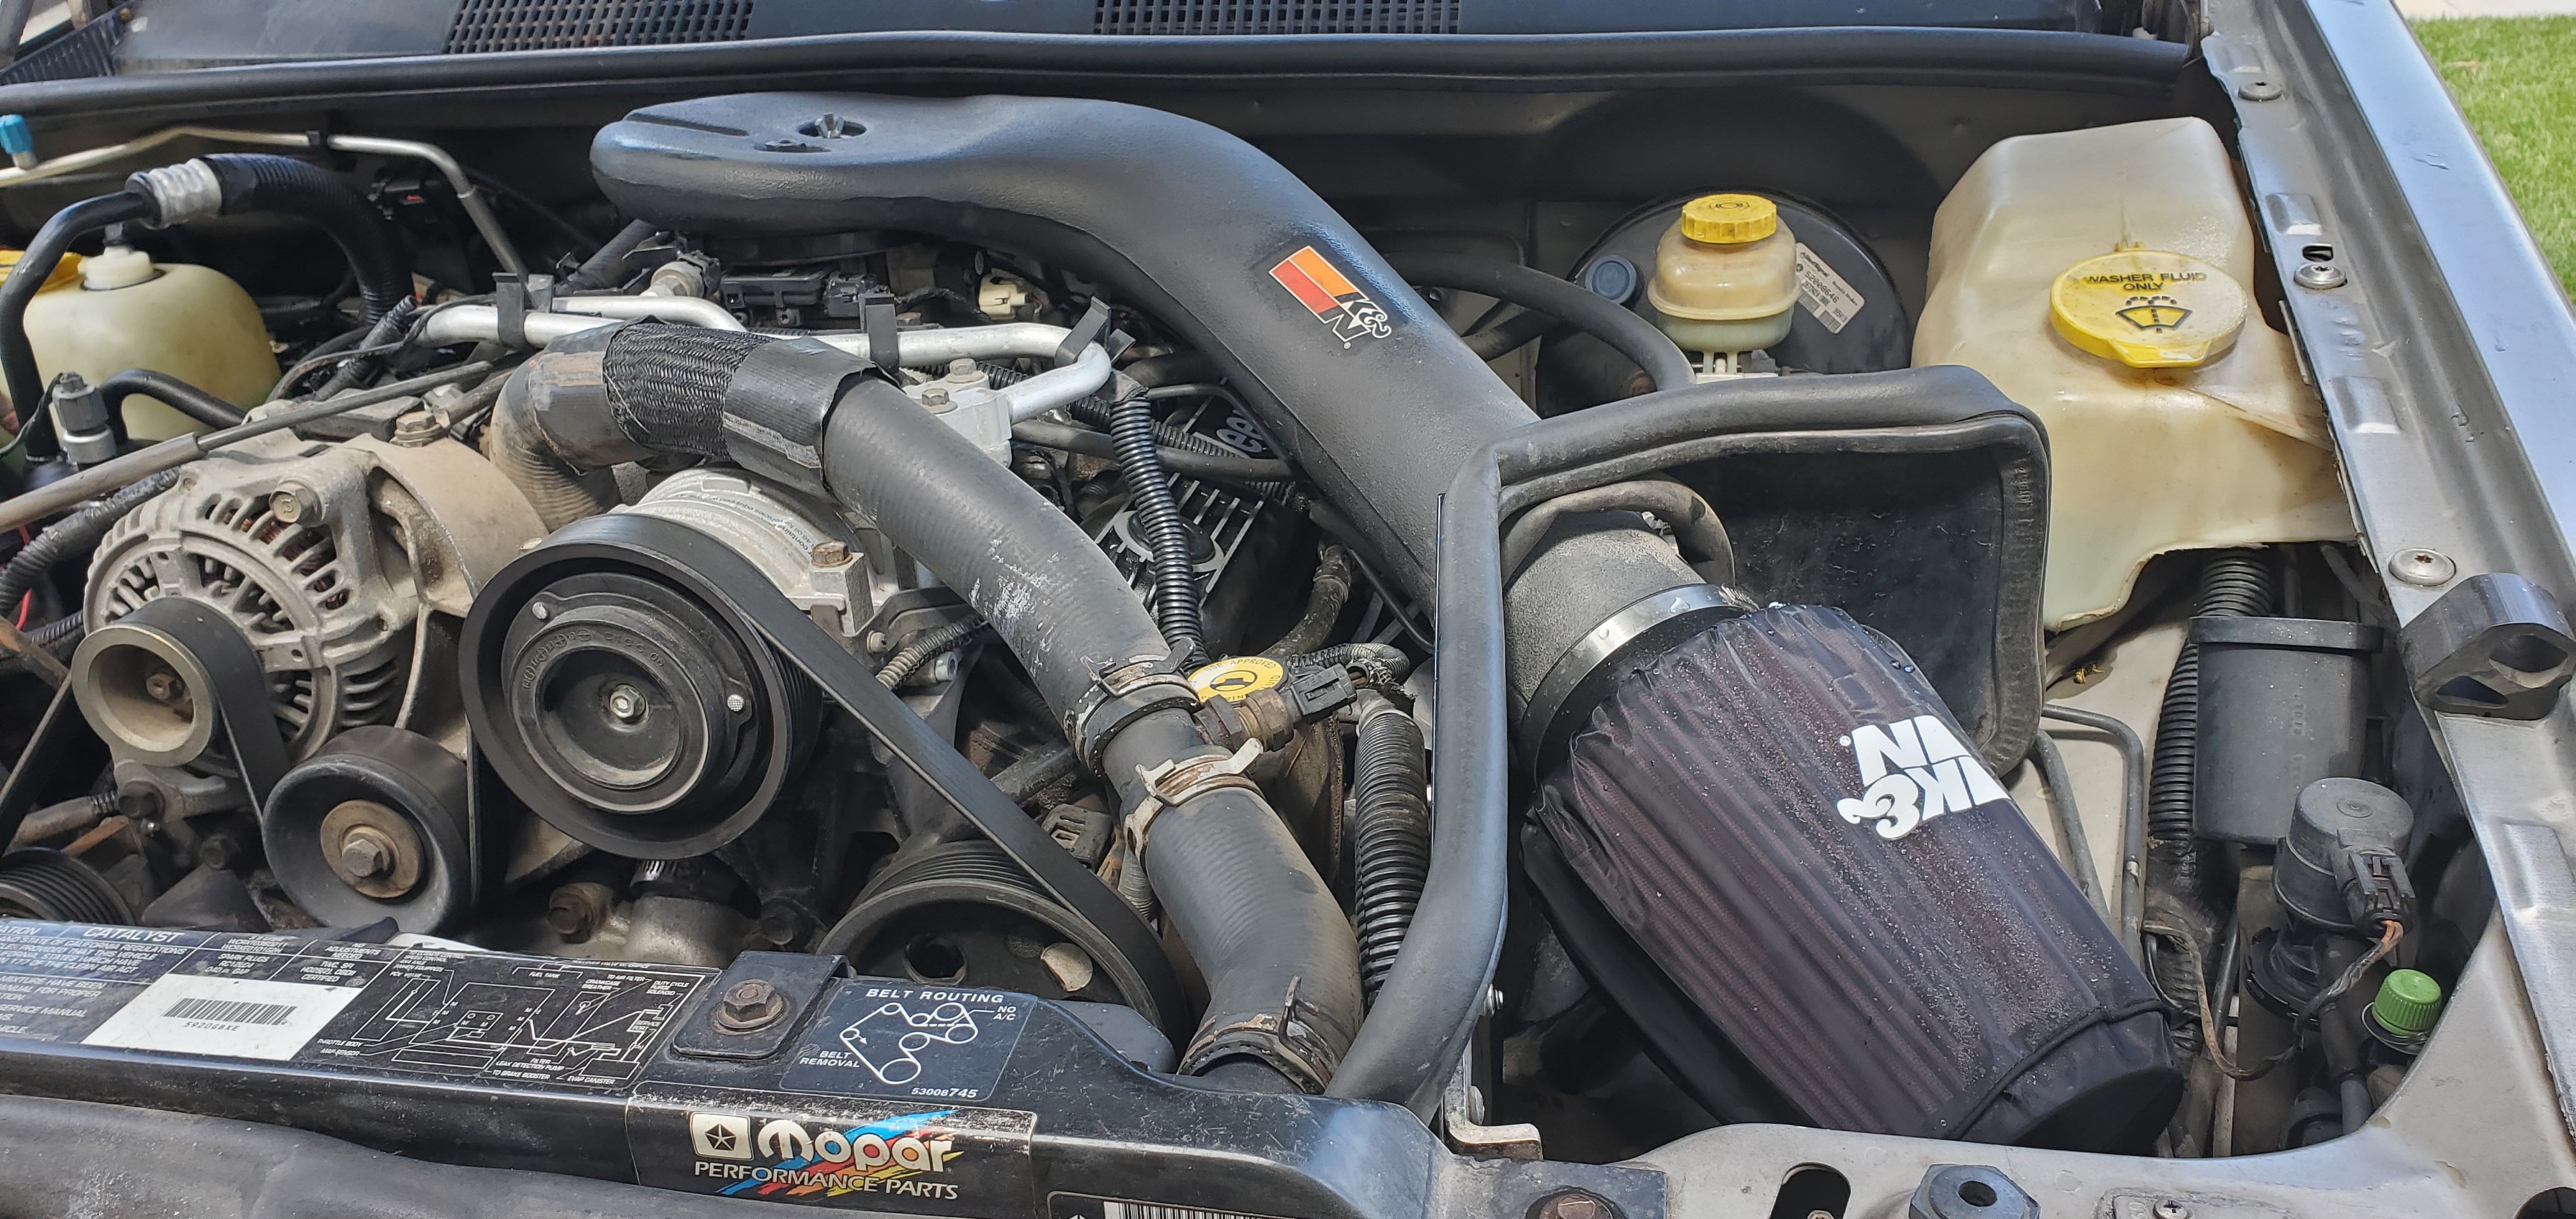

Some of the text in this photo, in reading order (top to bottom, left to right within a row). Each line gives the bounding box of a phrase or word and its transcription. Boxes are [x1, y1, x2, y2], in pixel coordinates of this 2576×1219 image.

[2083, 272, 2207, 283] WASHER FLUID
[2123, 283, 2164, 291] ONLY
[717, 498, 754, 512] equipped
[754, 509, 784, 523] vehicles
[784, 519, 794, 528] for
[793, 526, 802, 535] oil
[777, 524, 808, 551] contains
[802, 534, 811, 543] 46
[1204, 658, 1276, 673] USE APPROVED
[1837, 715, 2009, 840] K&N
[84, 927, 185, 943] CATALYST
[19, 945, 67, 953] PROVIDED
[118, 951, 160, 960] VEHICLE
[65, 940, 121, 949] CALIFORNIA
[120, 944, 188, 954] REGULATIONS
[325, 946, 381, 956] ADJUSTMENTS
[41, 953, 79, 962] STATES
[64, 962, 99, 970] CLEAN
[301, 974, 341, 982] CERTIFIED
[56, 988, 102, 997] PROPER
[866, 988, 1005, 1003] BELT ROUTING
[0, 1004, 88, 1018] SERVICE MANUAL
[993, 1013, 1016, 1021] A/C
[818, 1051, 852, 1059] BELT
[511, 1061, 546, 1070] DETECTION
[799, 1057, 861, 1068] REMOVAL
[911, 1087, 978, 1098] 53008745
[694, 1161, 959, 1200] PERFORMANCE PARTS
